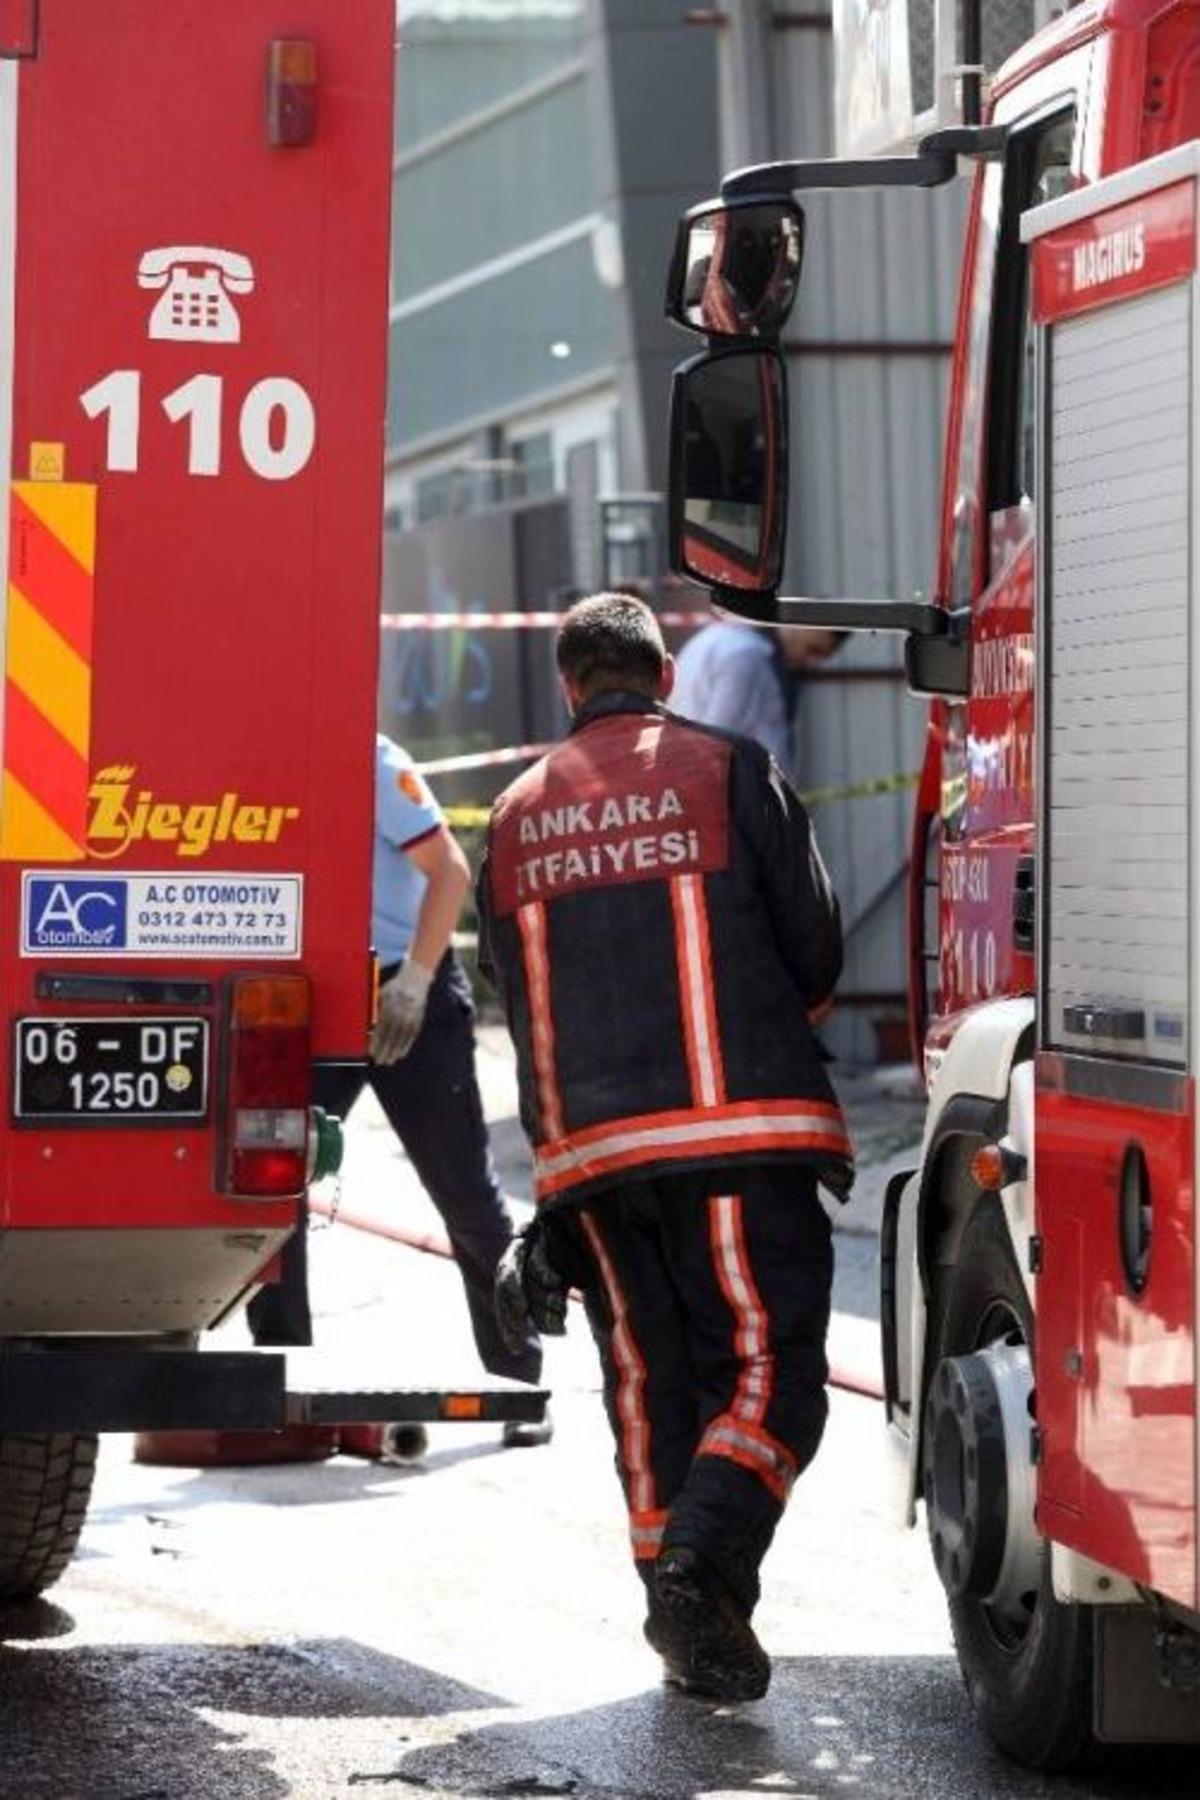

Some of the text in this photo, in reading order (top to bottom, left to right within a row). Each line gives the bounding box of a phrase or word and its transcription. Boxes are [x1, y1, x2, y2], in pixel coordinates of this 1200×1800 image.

[1073, 222, 1146, 292] MAGIRUS
[79, 370, 316, 480] 110
[86, 768, 300, 857] Ziegler
[519, 788, 684, 845] ANKARA
[36, 882, 117, 934] AC
[138, 911, 287, 928] 0312 473 72 73
[146, 885, 177, 904] A.C
[25, 1028, 78, 1064] 06
[140, 1026, 200, 1064] DF
[68, 1072, 160, 1110] 1250
